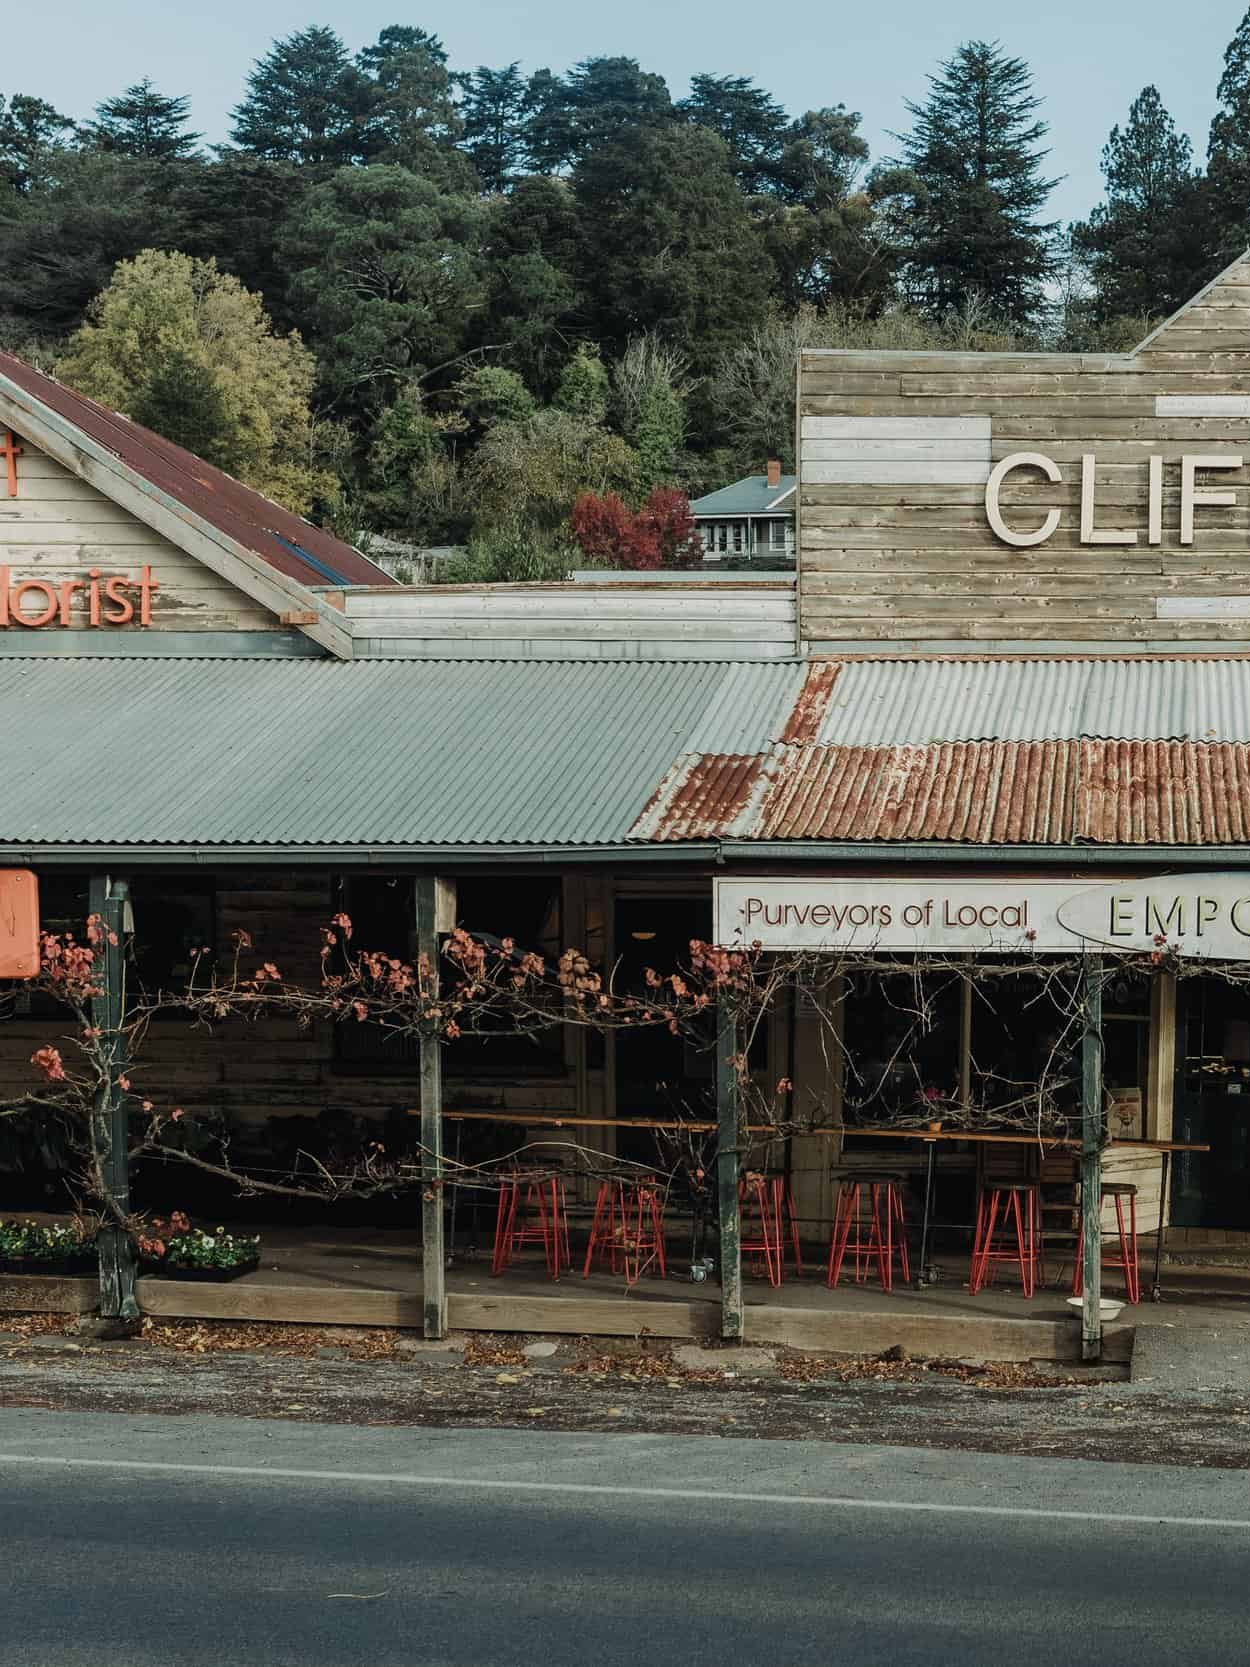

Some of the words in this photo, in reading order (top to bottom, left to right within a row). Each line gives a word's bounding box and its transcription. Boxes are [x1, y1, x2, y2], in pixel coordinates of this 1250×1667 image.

[746, 897, 892, 930] Purveyors
[903, 899, 934, 927] of
[944, 899, 1029, 928] Local
